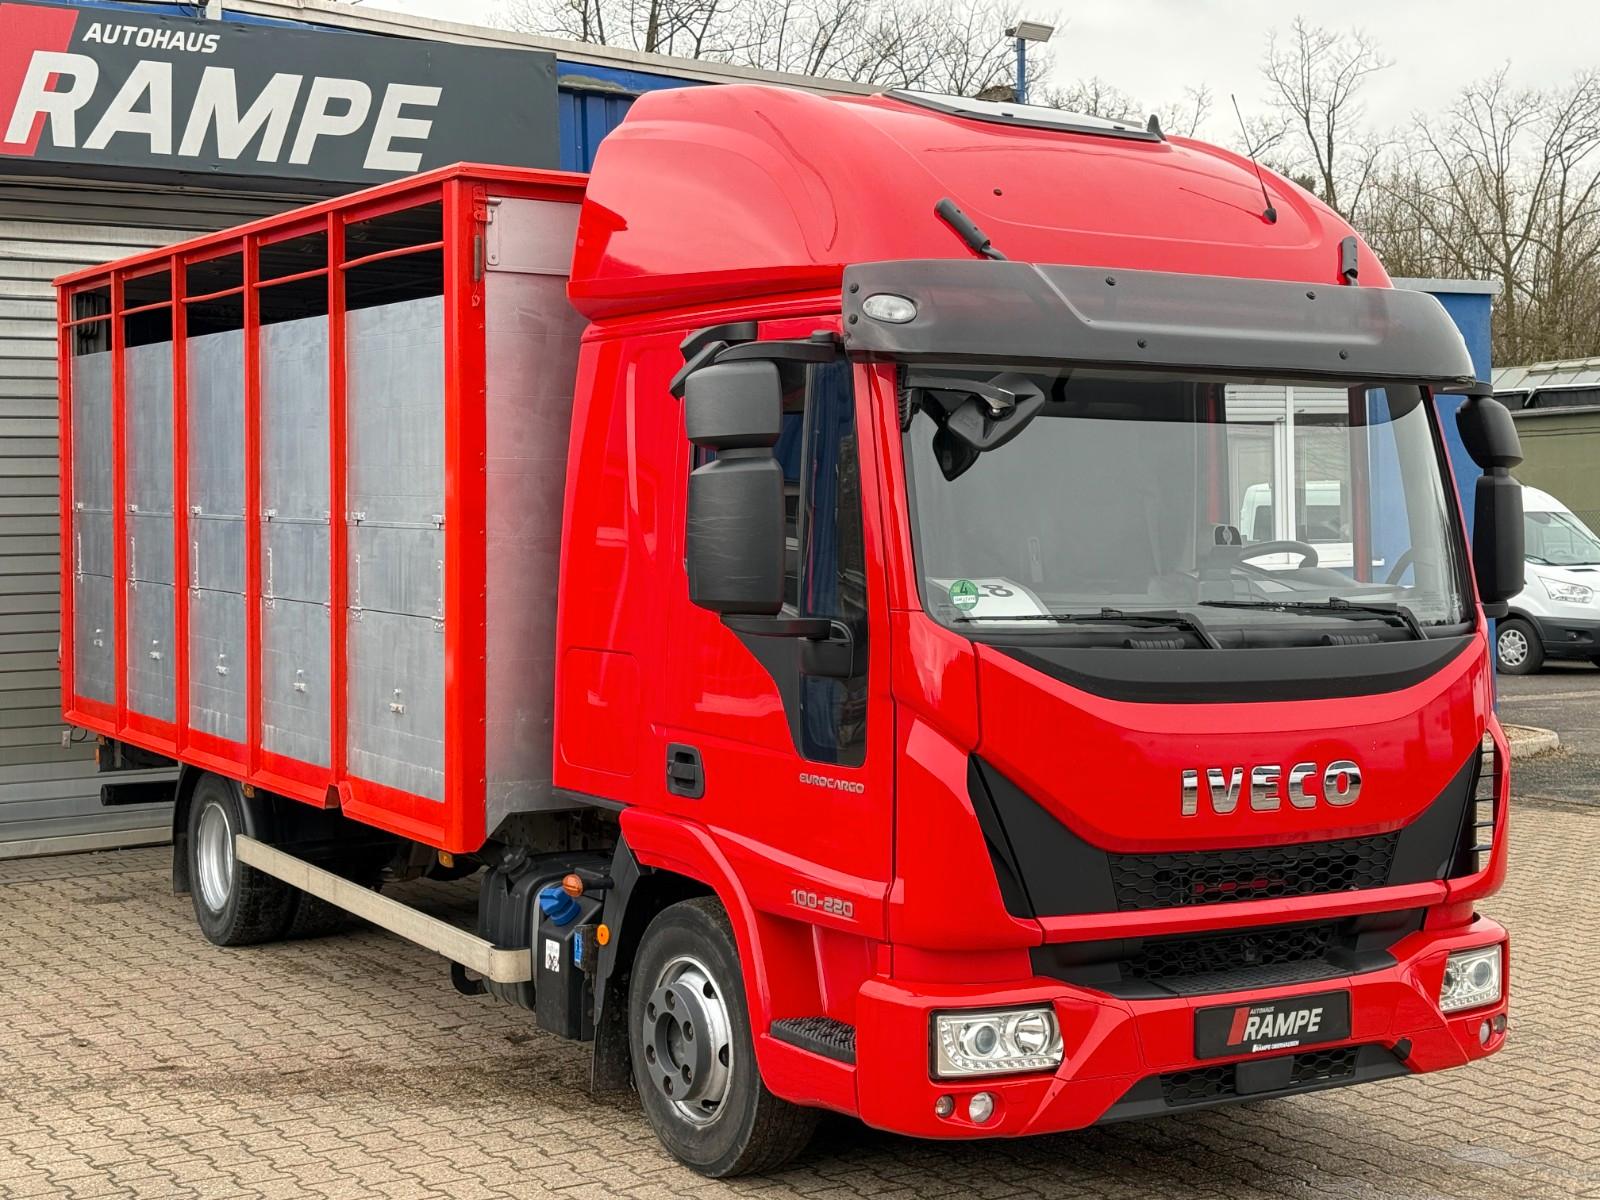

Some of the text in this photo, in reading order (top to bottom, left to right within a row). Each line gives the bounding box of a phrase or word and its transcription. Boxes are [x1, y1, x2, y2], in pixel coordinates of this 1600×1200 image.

[83, 23, 220, 53] AUTOHAUS
[4, 50, 443, 173] RAMPE
[799, 772, 865, 794] EUROCARGO
[1181, 760, 1362, 817] IVECO
[791, 888, 854, 918] 100-220
[1243, 1007, 1324, 1042] RAMPE
